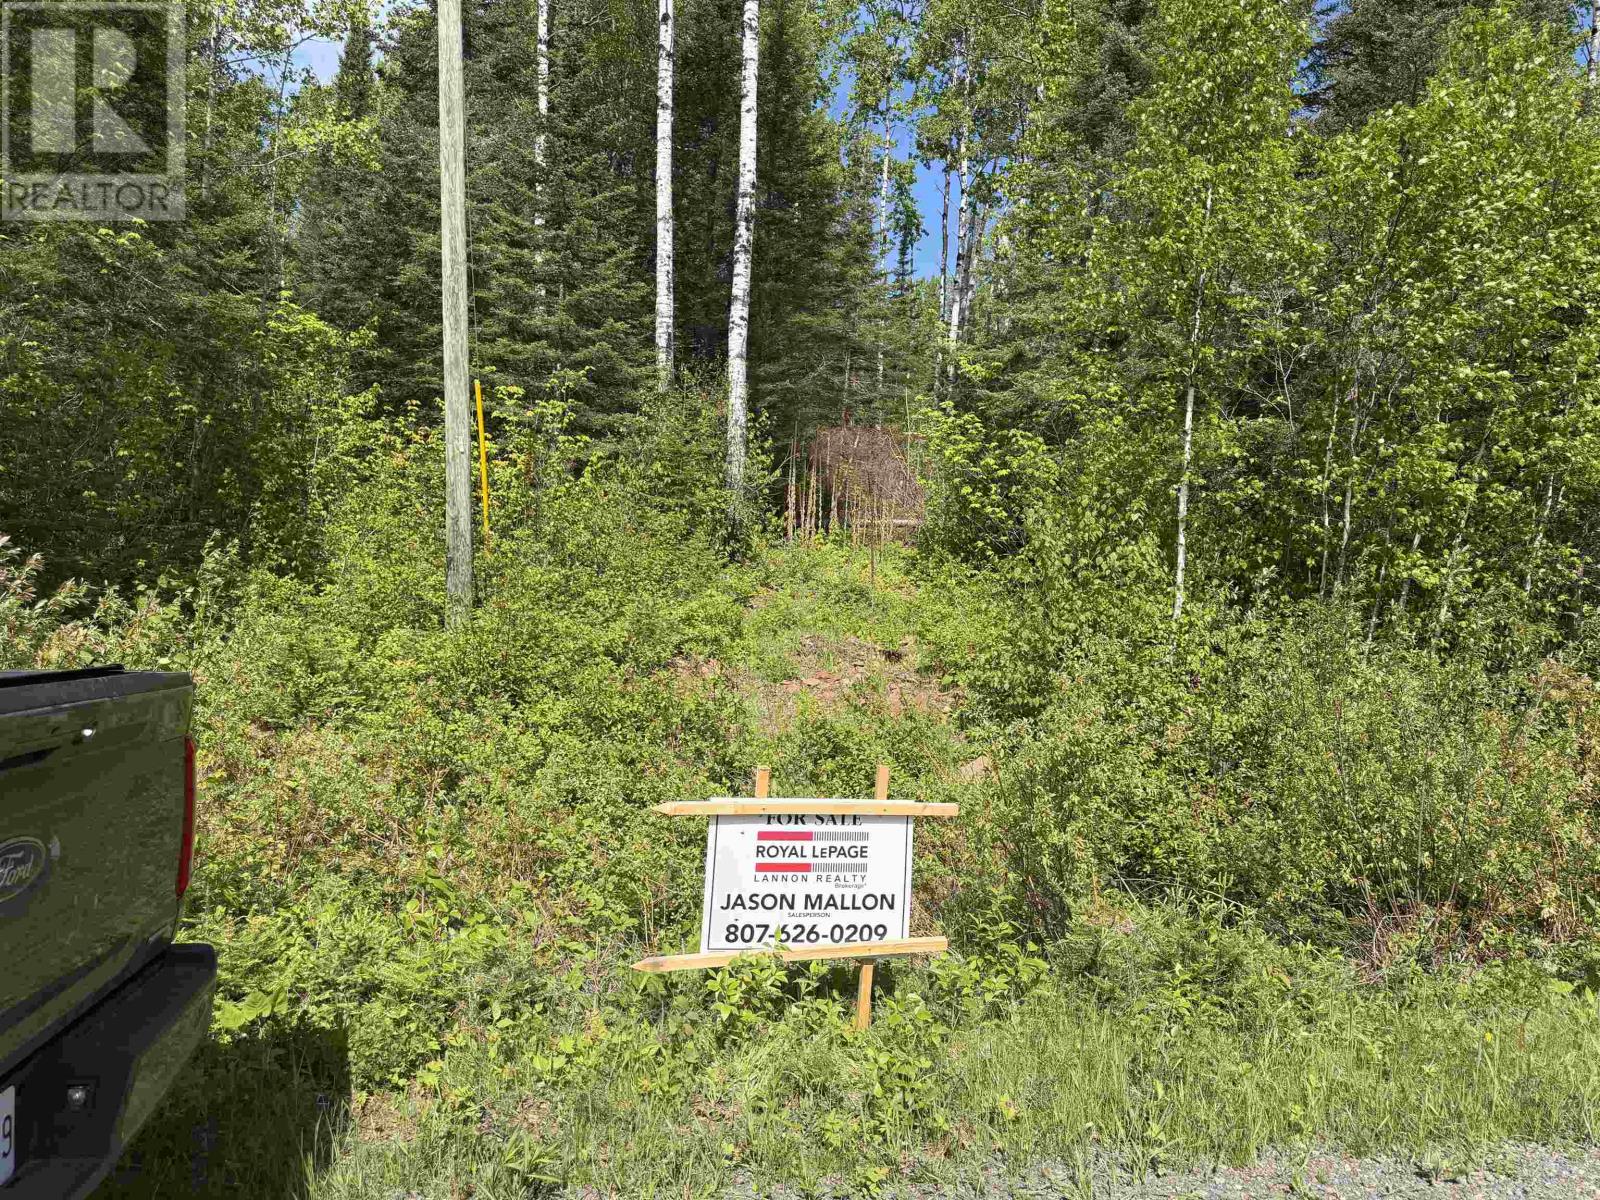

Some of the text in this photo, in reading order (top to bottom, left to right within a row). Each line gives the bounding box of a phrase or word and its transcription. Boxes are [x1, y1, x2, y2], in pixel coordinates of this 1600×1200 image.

[766, 814, 862, 826] FOR SALE
[756, 845, 807, 858] ROYAL
[754, 874, 867, 882] LANNON REALTY
[720, 893, 896, 910] JASON MALLON
[725, 923, 888, 943] 807-626-0209
